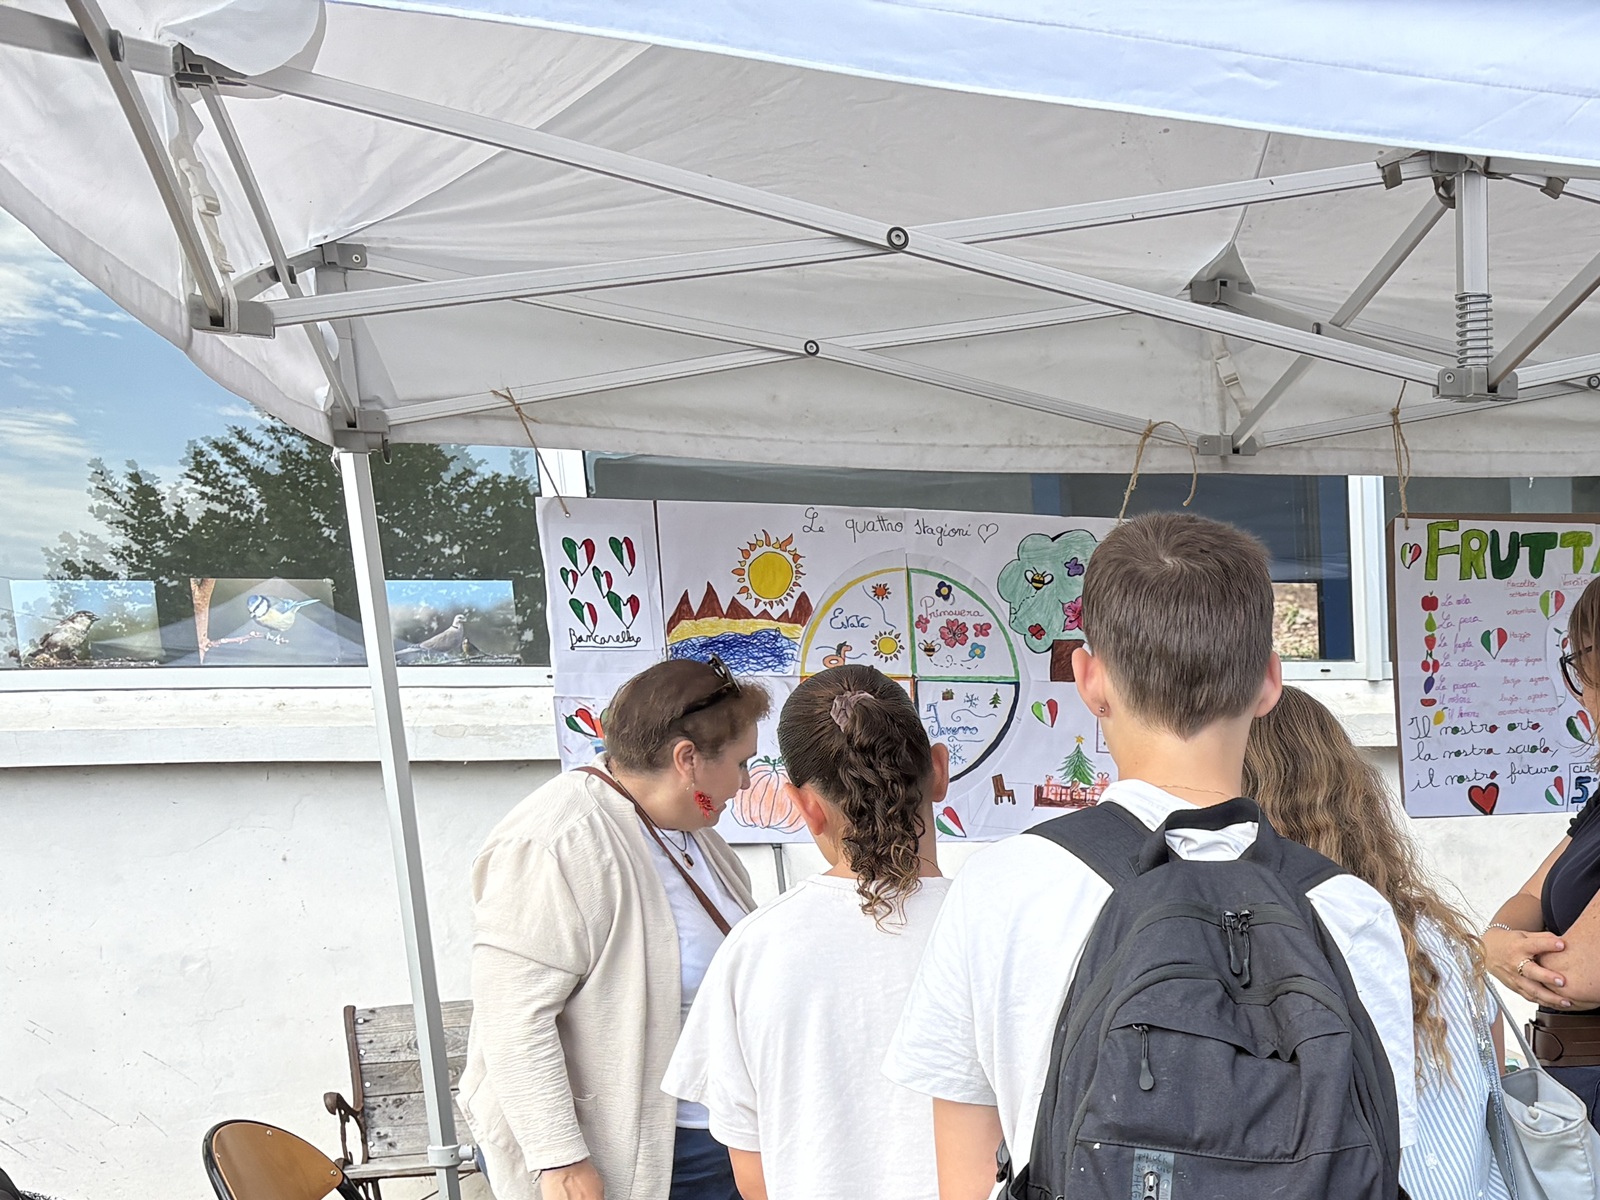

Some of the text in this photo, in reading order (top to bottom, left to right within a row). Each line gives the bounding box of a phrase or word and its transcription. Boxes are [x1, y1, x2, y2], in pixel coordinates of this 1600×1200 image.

[830, 608, 871, 629] Estate
[920, 596, 984, 619] Primavera
[1459, 616, 1483, 632] pera
[1408, 716, 1431, 739] Il
[1440, 721, 1499, 735] nostro
[1411, 741, 1438, 762] la
[1443, 744, 1500, 759] nostra
[1411, 768, 1440, 792] il
[1445, 770, 1498, 785] nostro
